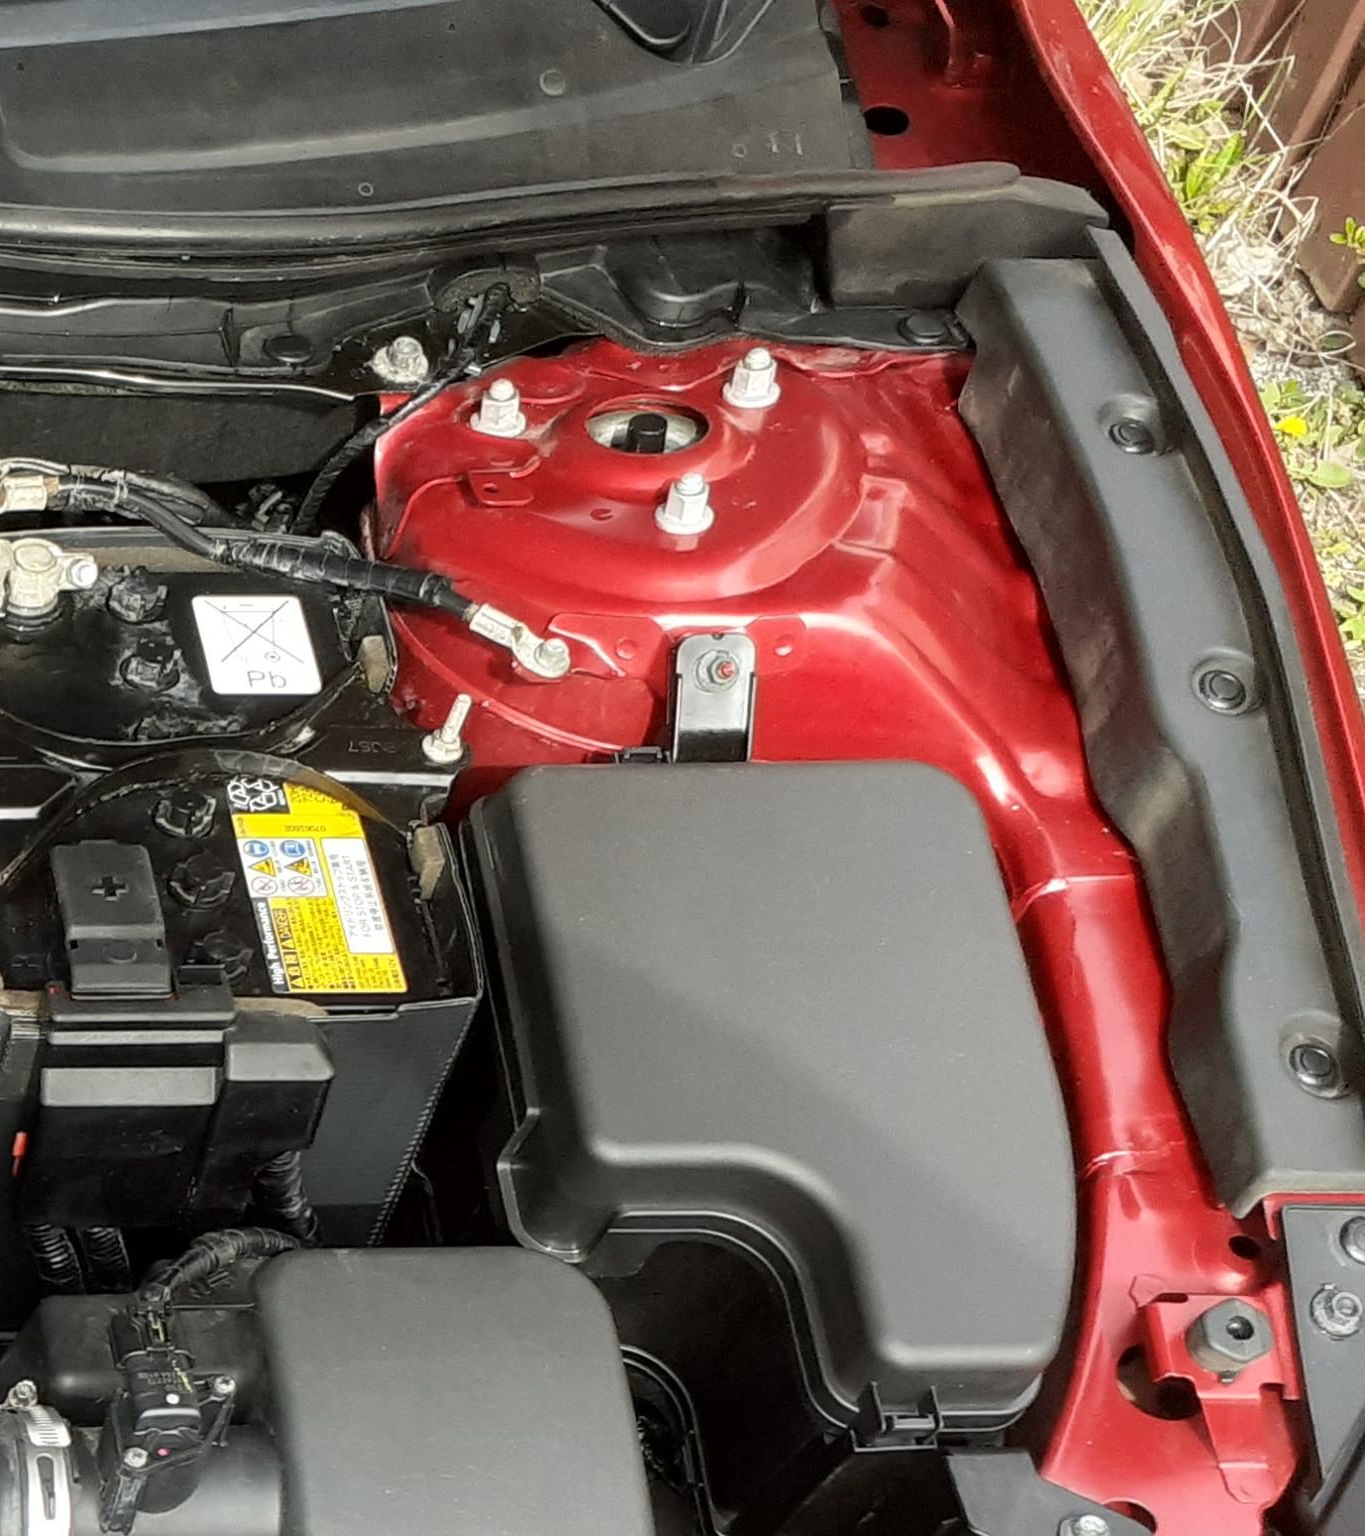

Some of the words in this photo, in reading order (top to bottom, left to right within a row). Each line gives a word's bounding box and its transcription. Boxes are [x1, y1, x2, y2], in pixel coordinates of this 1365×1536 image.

[247, 670, 287, 688] Pb
[342, 855, 358, 882] START
[353, 892, 369, 916] STOP
[257, 902, 281, 960] Performance
[357, 919, 372, 937] FOR
[268, 961, 285, 985] High
